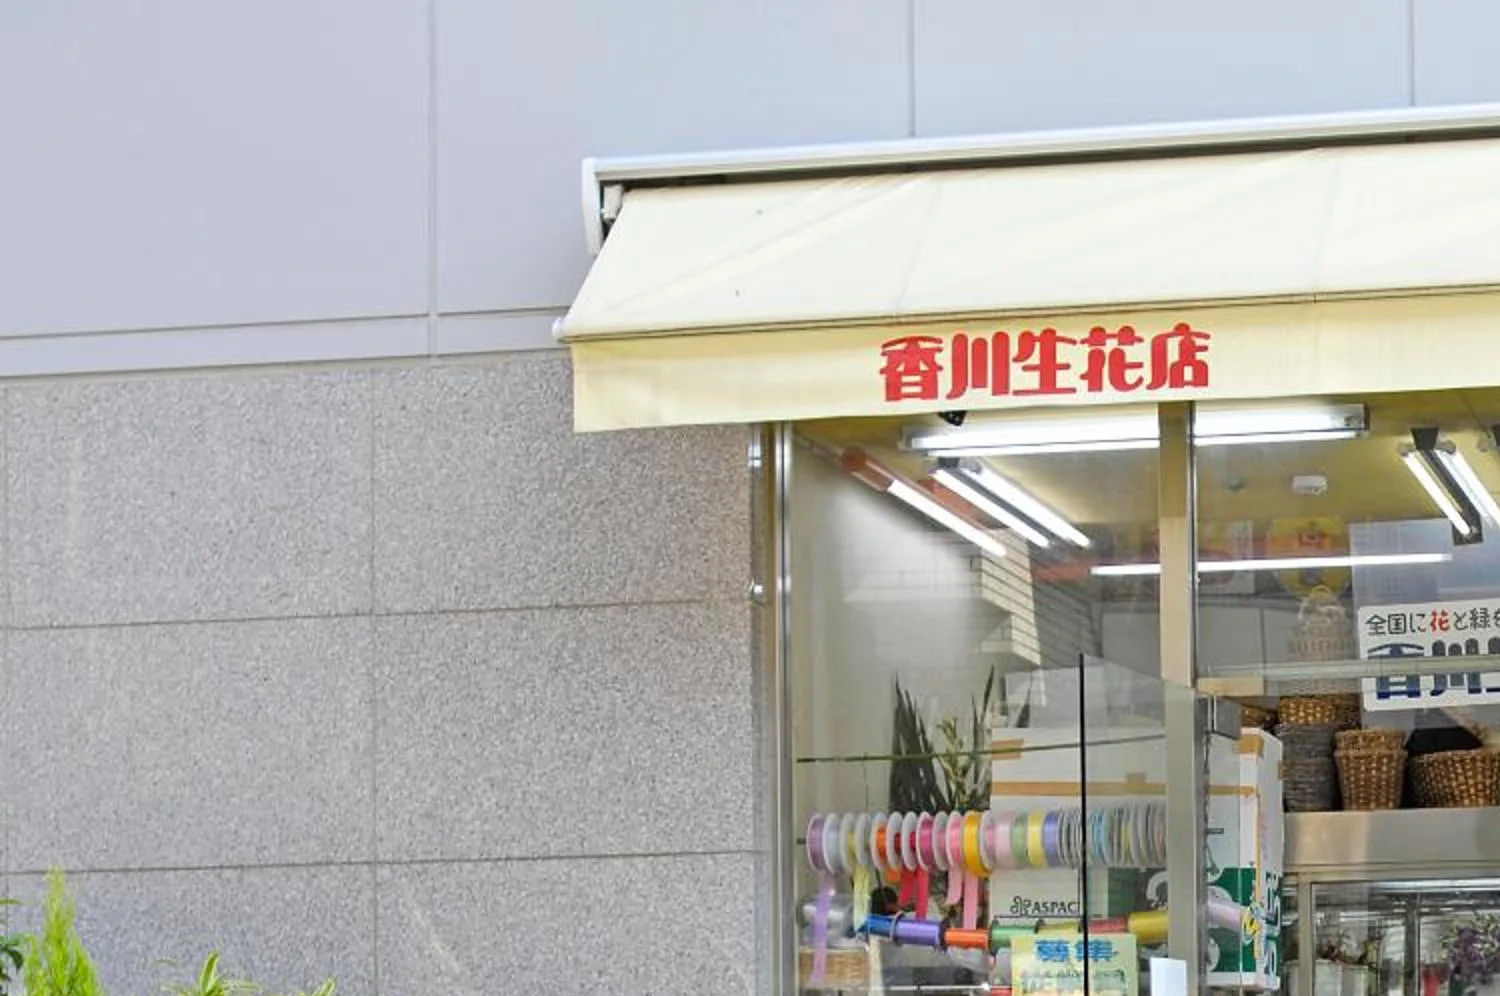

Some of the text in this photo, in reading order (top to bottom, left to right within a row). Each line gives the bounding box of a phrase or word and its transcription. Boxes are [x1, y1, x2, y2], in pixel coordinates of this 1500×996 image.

[879, 322, 1211, 402] 香川生花店
